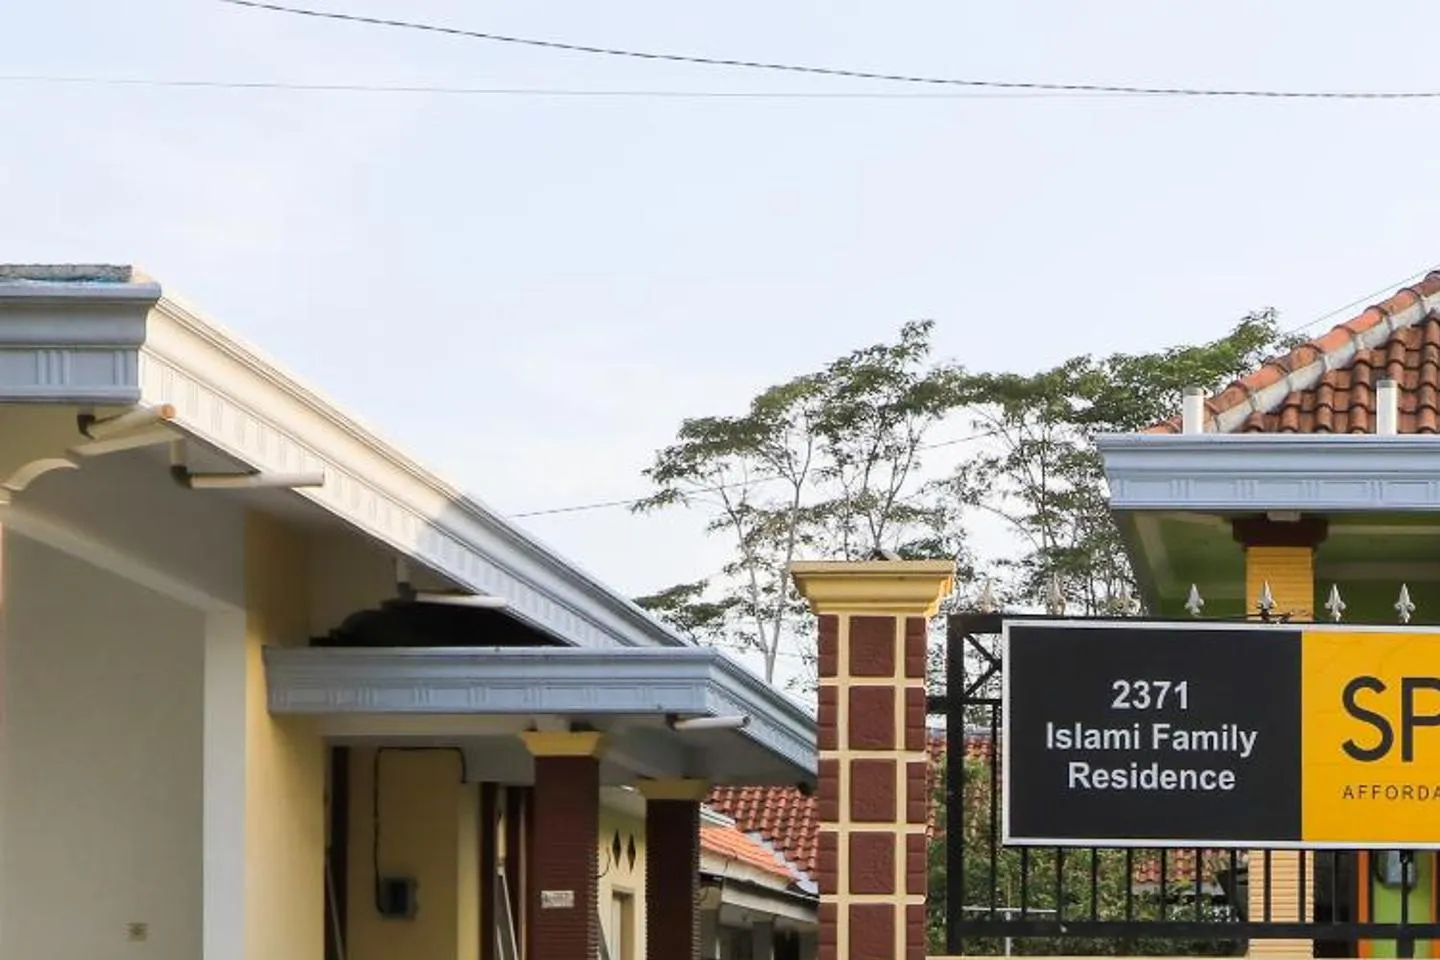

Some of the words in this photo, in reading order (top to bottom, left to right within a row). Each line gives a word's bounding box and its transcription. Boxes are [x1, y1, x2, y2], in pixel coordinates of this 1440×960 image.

[1111, 679, 1188, 710] 2371
[1046, 721, 1140, 750] Islami
[1152, 723, 1258, 758] Family
[1068, 761, 1236, 791] Residence
